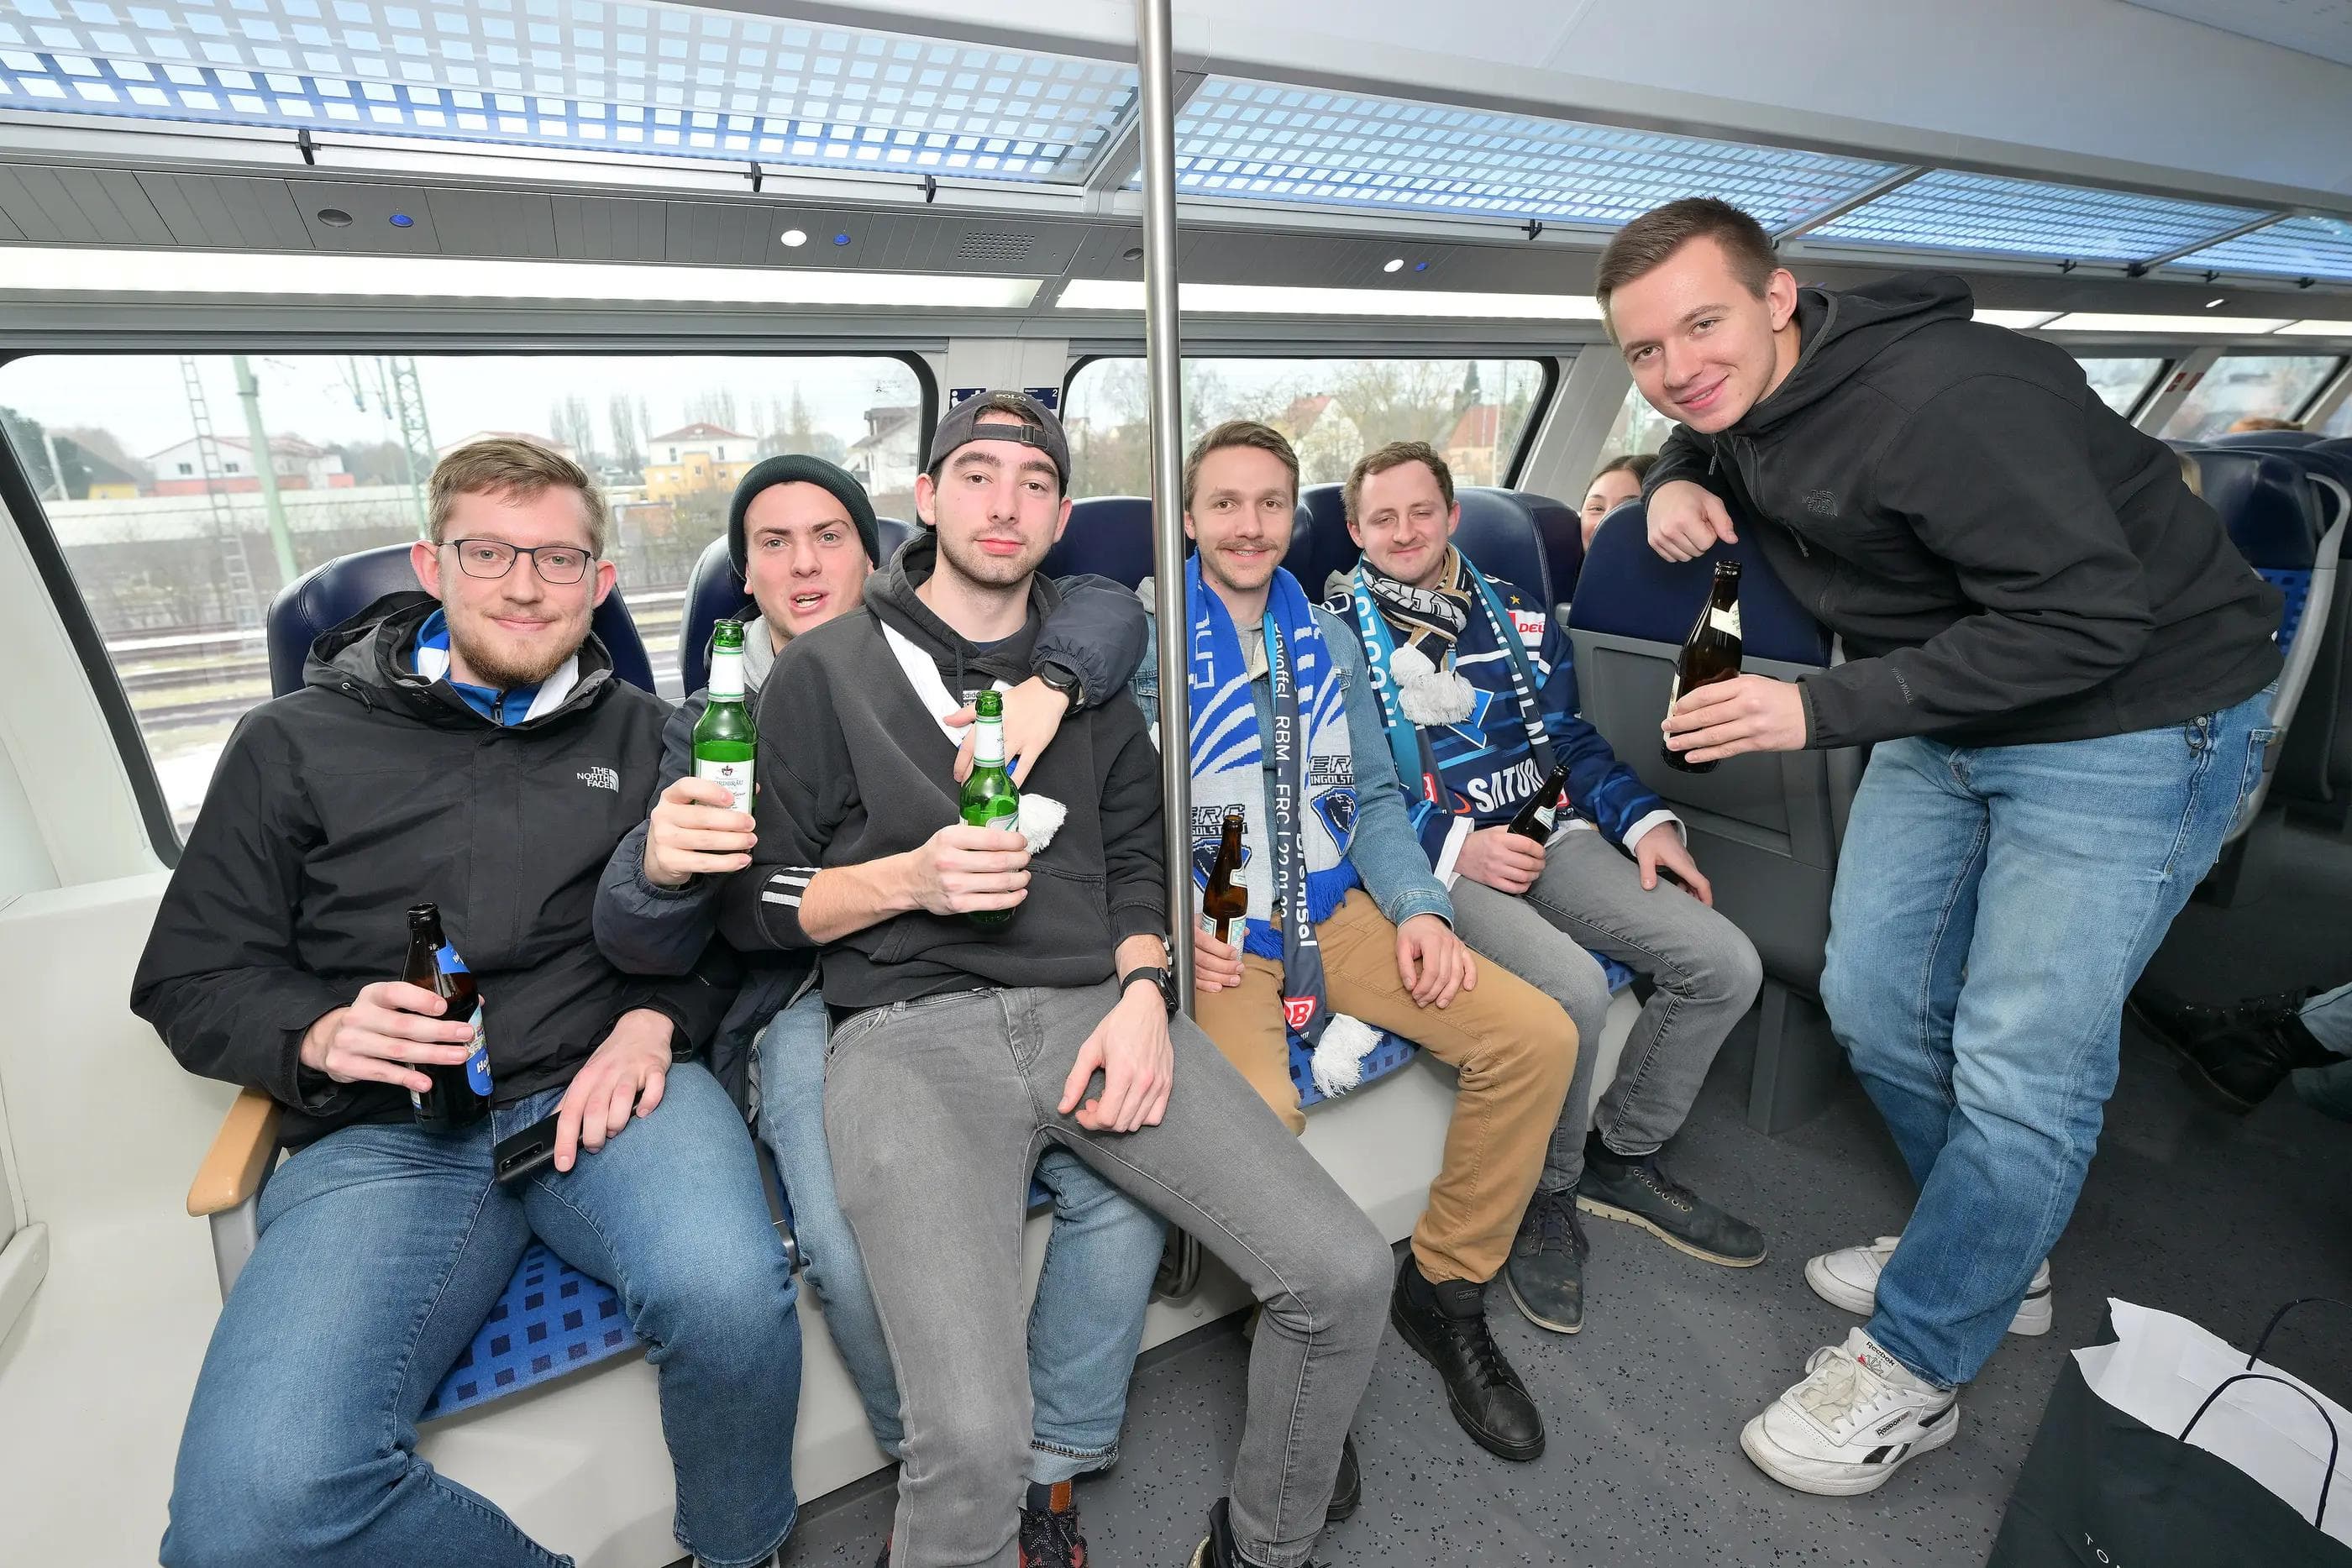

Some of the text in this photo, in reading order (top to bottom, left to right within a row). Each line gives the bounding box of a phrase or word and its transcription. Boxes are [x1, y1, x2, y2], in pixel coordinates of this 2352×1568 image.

[1052, 389, 1058, 397] 2
[1275, 716, 1290, 761] RBM
[591, 766, 609, 774] THE
[1310, 755, 1353, 774] ER
[576, 772, 610, 782] NORTH
[586, 779, 610, 789] FACE
[1467, 758, 1546, 813] SATUR
[1866, 1341, 1895, 1366] Reebok
[1876, 1418, 1902, 1436] Reebok
